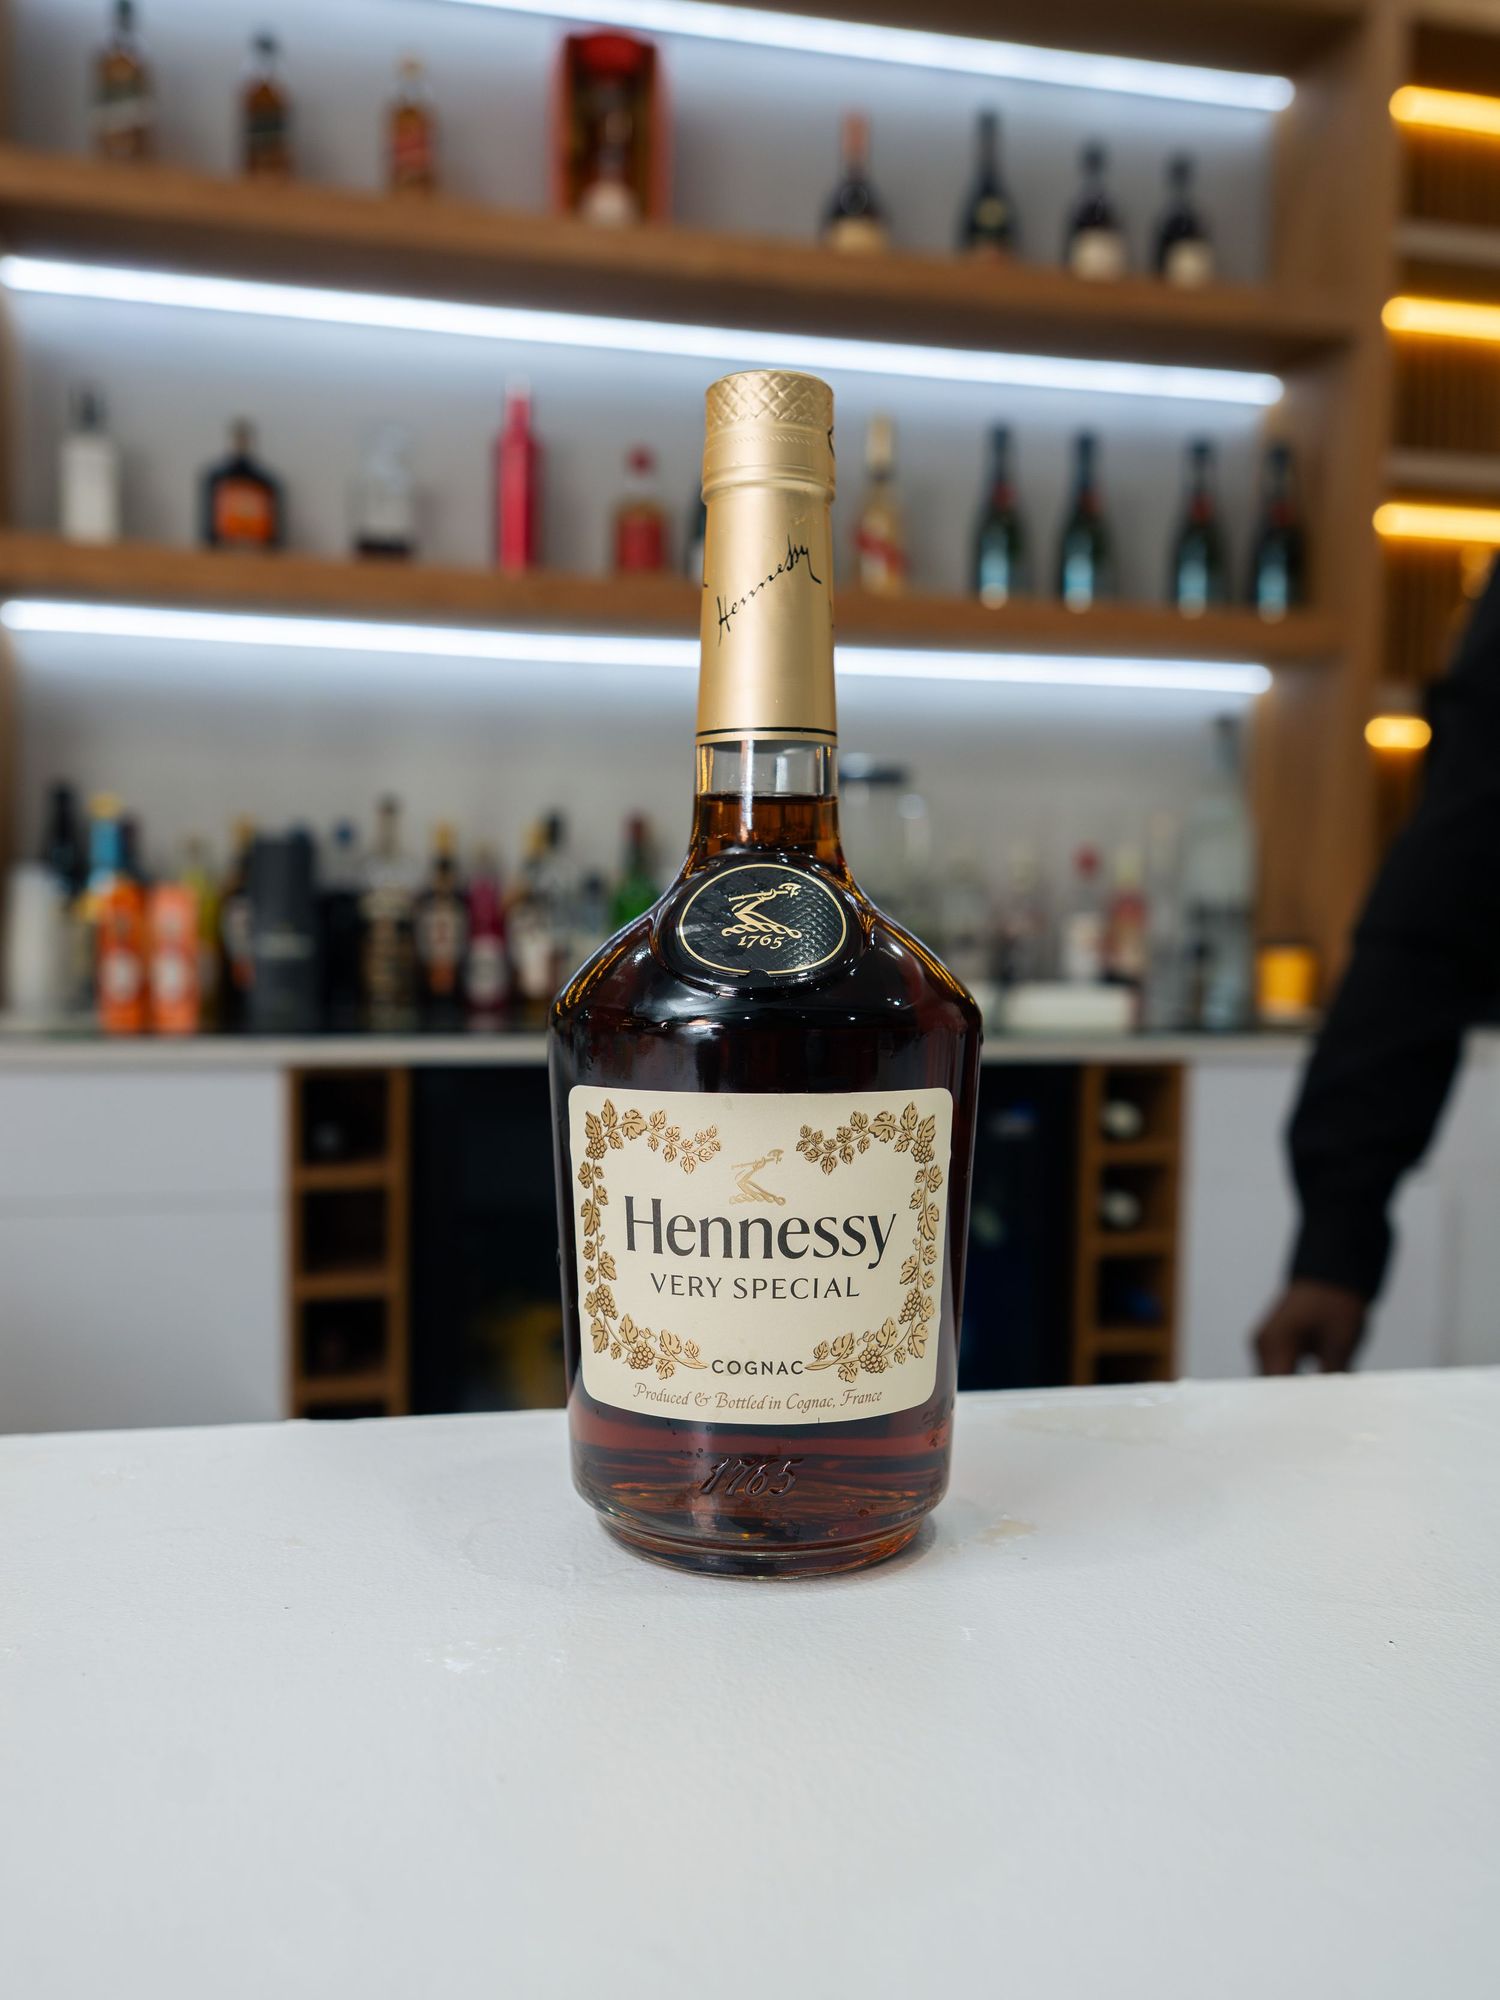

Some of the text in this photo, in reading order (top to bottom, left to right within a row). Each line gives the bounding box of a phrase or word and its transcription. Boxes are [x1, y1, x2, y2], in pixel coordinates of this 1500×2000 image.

[716, 534, 822, 646] Hennessy
[738, 934, 785, 950] 1765
[624, 1195, 897, 1270] Hennessy
[650, 1272, 860, 1301] VERY SPECIAL
[711, 1359, 804, 1376] COGNAC
[633, 1382, 883, 1413] Produced & Bottled in Cognac, France
[701, 1457, 804, 1497] 1765
